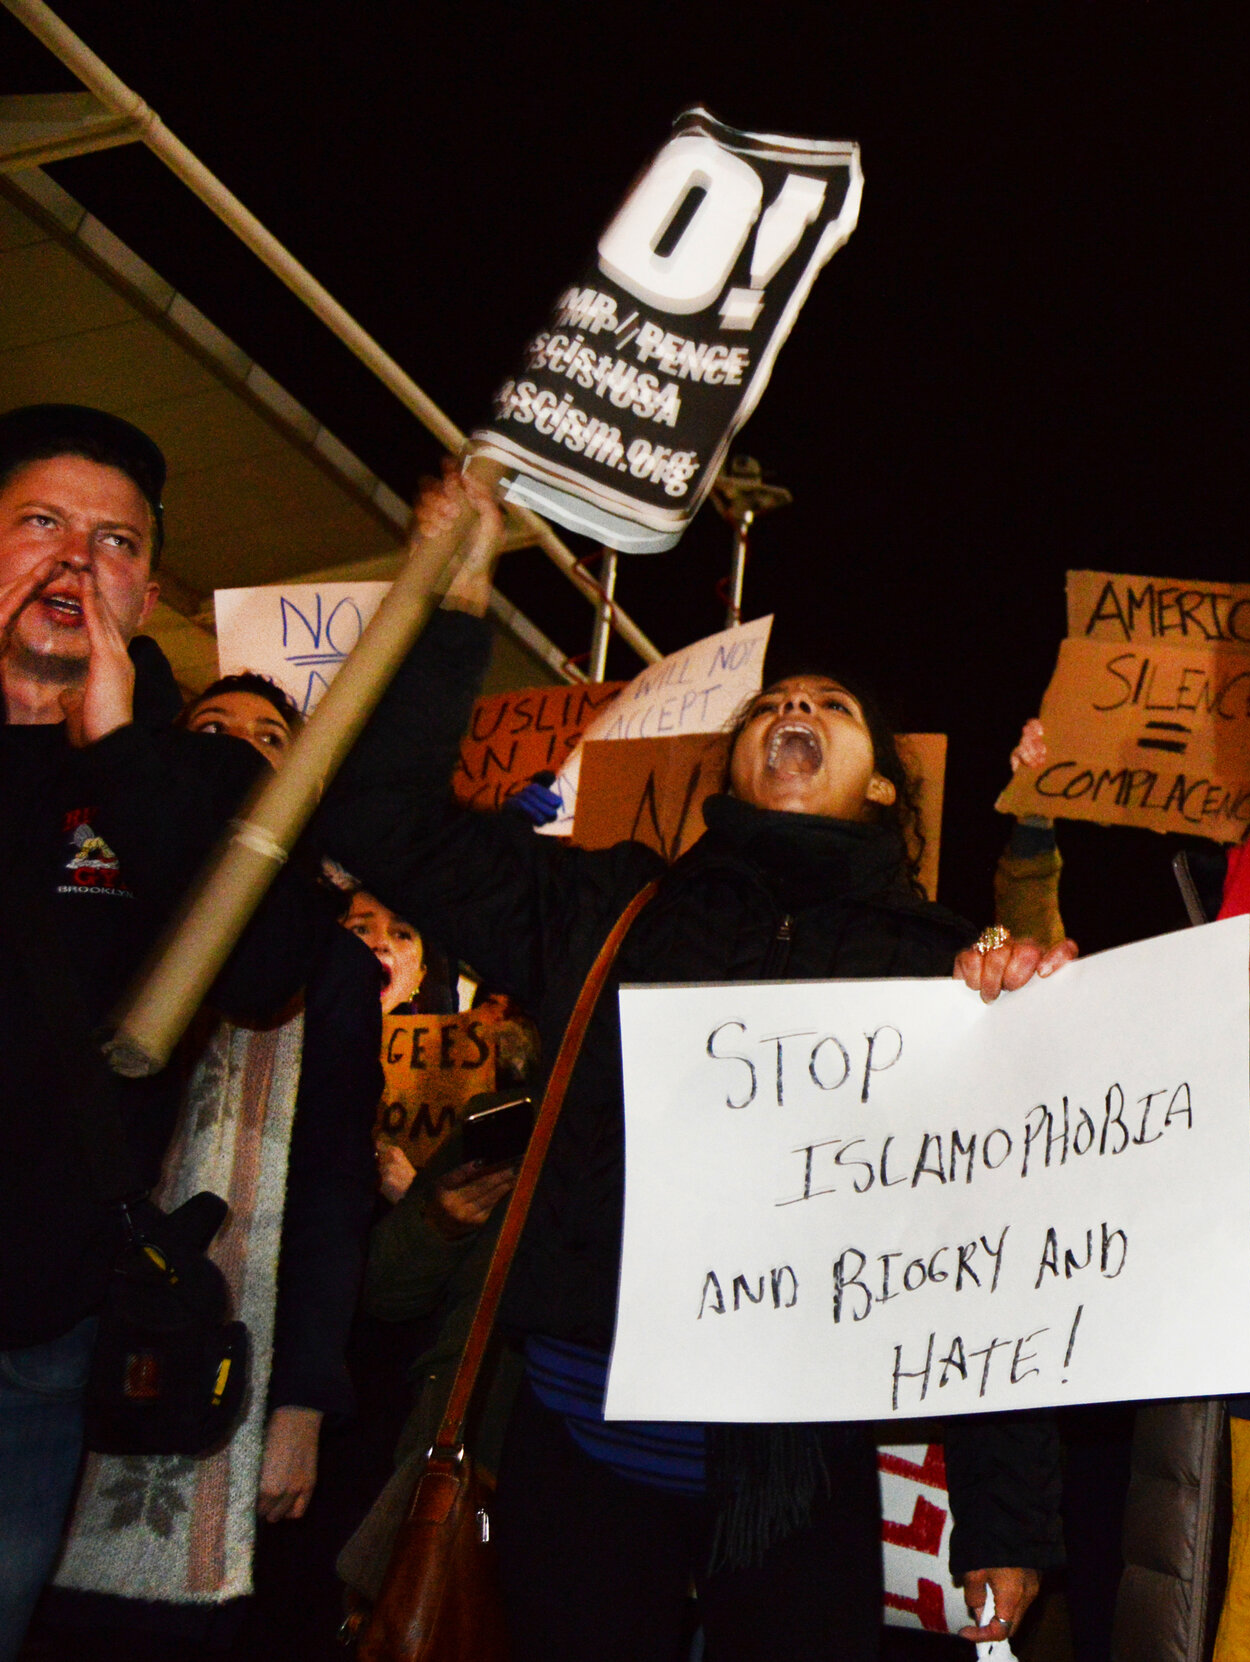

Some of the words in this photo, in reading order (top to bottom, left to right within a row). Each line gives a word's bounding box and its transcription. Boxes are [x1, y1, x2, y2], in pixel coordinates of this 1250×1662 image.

[280, 593, 364, 650] NO
[708, 636, 765, 677] NOT
[604, 684, 722, 740] ACCEPT
[57, 885, 137, 899] BROOKLYN
[706, 1021, 903, 1109] STOP
[775, 1082, 1193, 1207] ISLAMOPHOBIA
[697, 1266, 799, 1320] AND
[832, 1225, 1011, 1324] BIOGRY
[1034, 1222, 1129, 1290] AND
[892, 1304, 1085, 1410] HATE!
